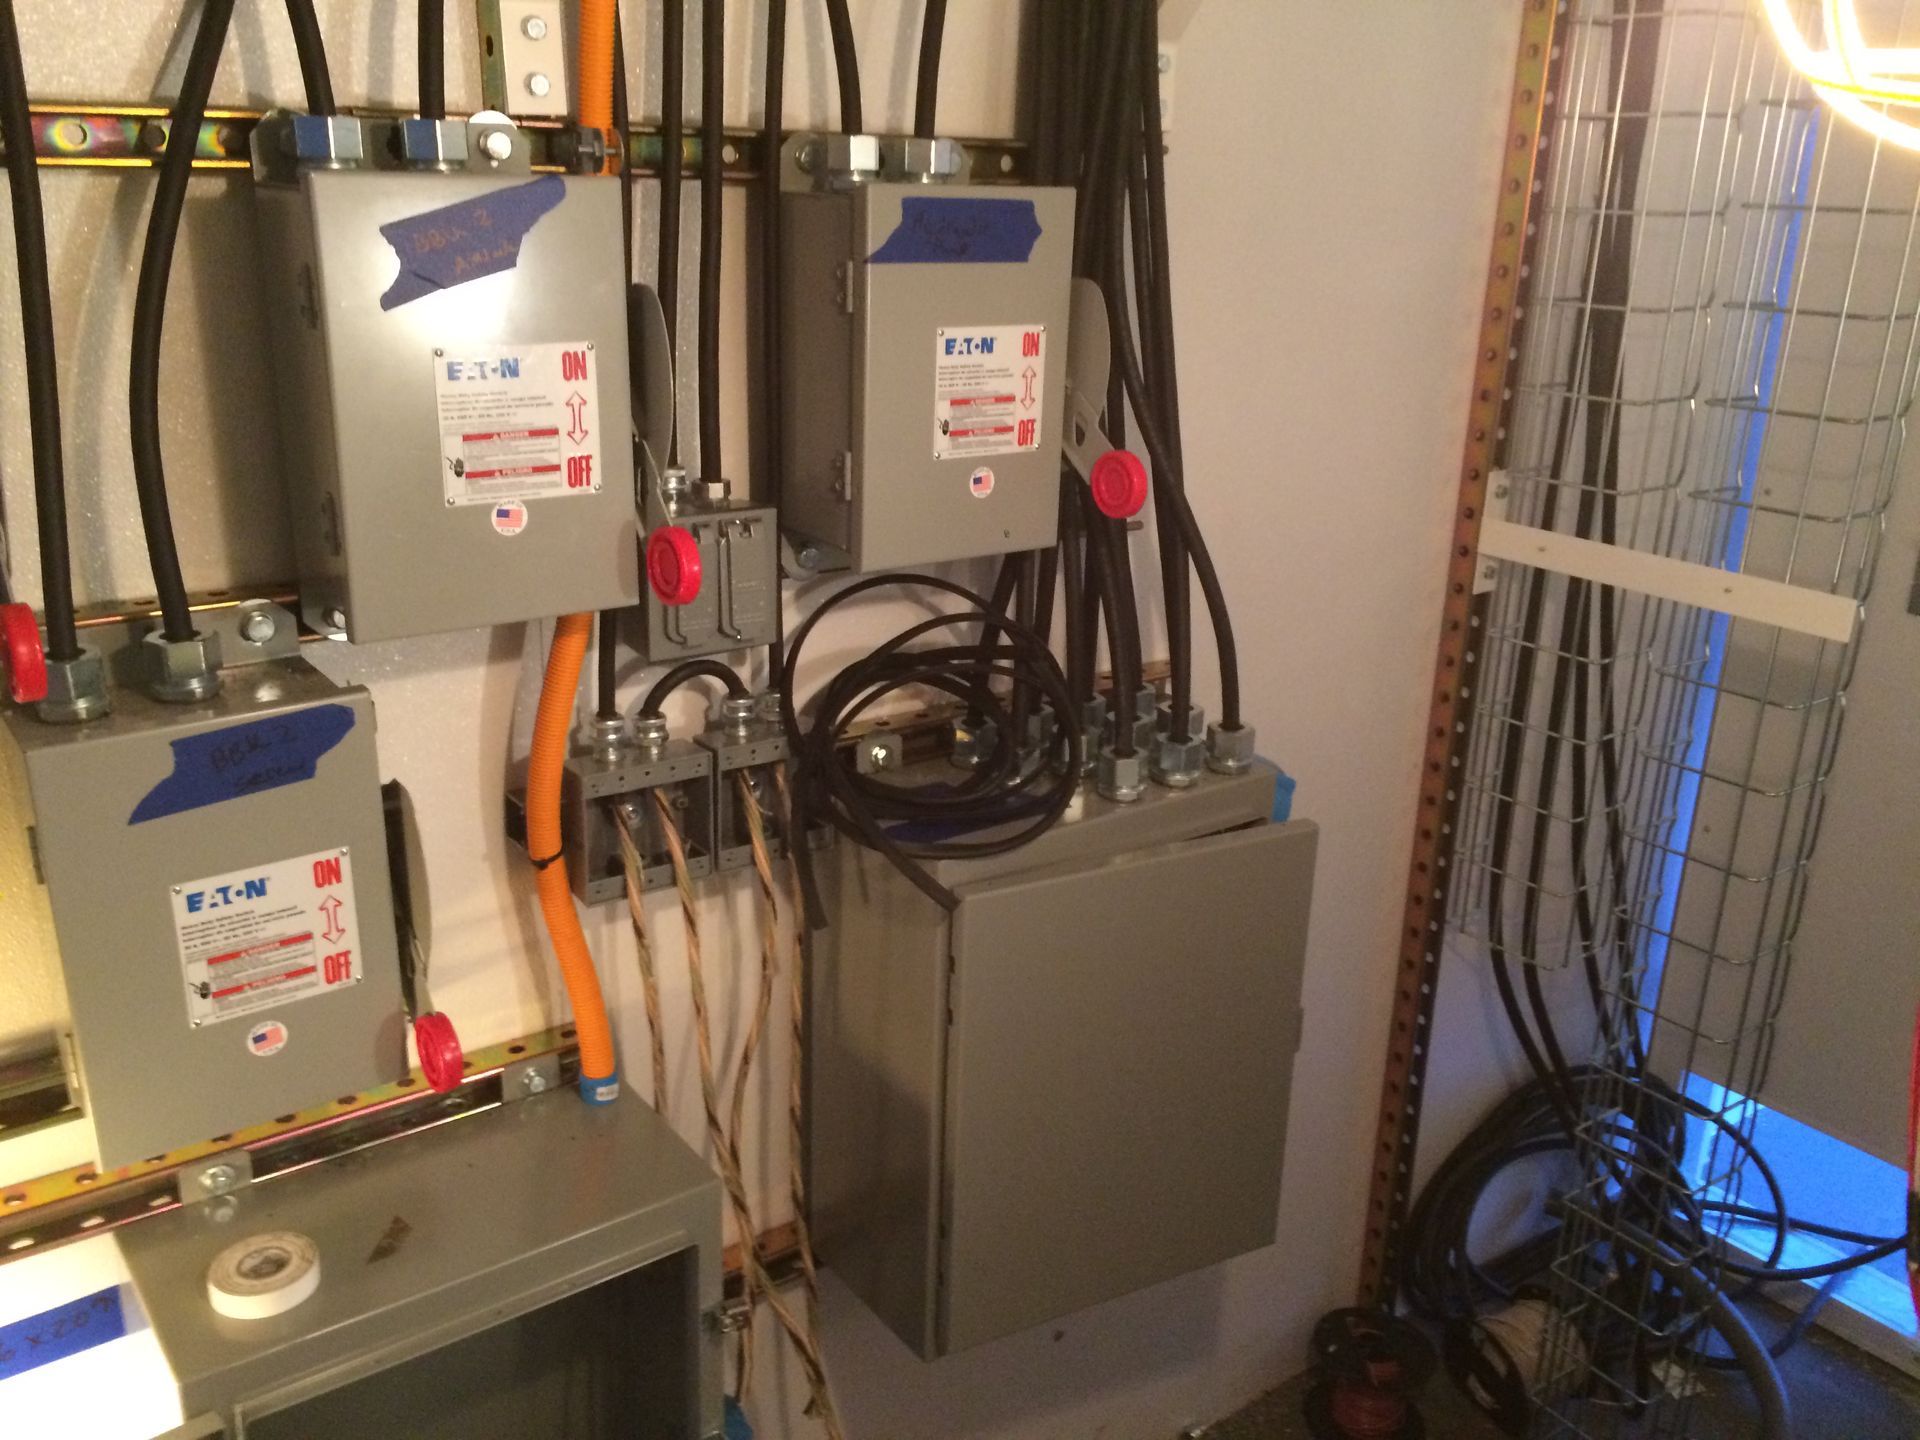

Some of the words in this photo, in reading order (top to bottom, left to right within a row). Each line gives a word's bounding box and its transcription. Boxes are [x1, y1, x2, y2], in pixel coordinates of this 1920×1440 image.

[945, 337, 994, 355] EATON
[1022, 332, 1040, 357] ON
[446, 358, 520, 381] EATON
[562, 351, 587, 381] ON
[1017, 419, 1037, 447] OFF
[567, 455, 592, 488] OFF
[313, 857, 342, 888] ON
[186, 878, 268, 913] EATON
[324, 950, 352, 985] OFF
